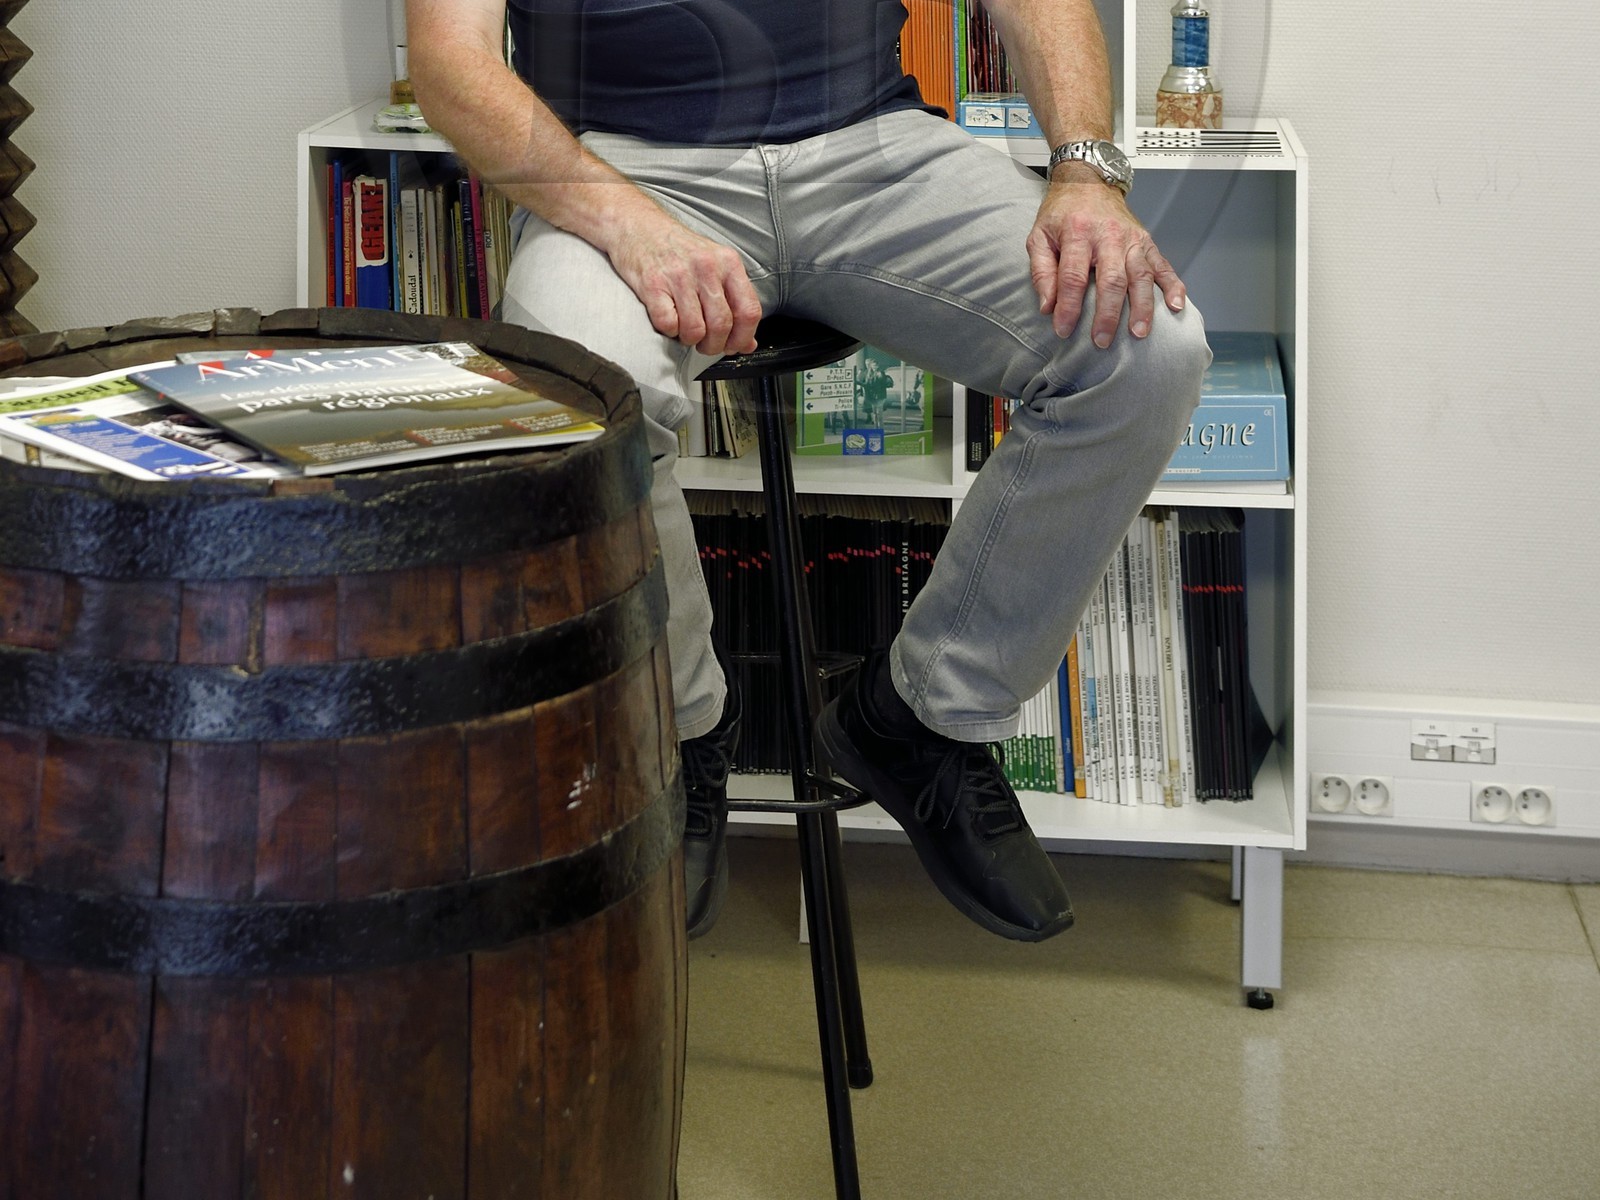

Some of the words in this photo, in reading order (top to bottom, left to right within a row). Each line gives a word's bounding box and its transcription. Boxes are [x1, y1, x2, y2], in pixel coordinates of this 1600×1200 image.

[360, 182, 384, 260] GEANT
[408, 275, 418, 314] Cadoudal
[238, 393, 332, 414] parcs
[336, 380, 473, 398] naturels
[322, 386, 494, 410] régionaux
